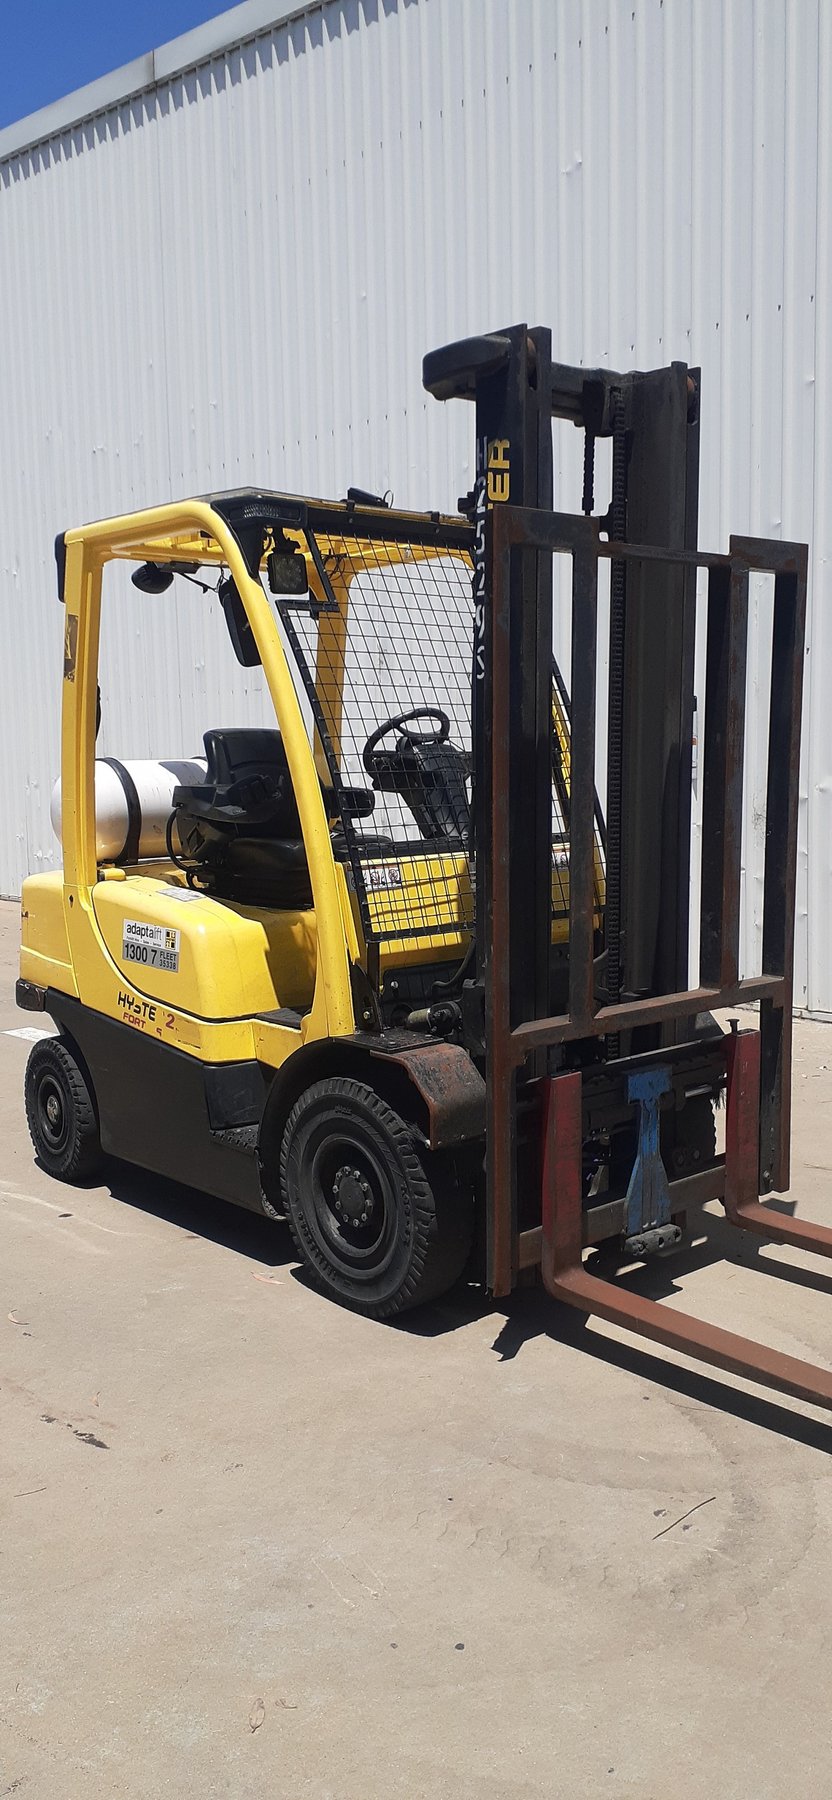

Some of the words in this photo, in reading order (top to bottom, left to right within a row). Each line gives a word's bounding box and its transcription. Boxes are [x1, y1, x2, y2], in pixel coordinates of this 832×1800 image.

[487, 439, 511, 510] ER
[125, 942, 148, 963] 1300
[151, 949, 158, 965] 7
[159, 950, 177, 962] FLEET
